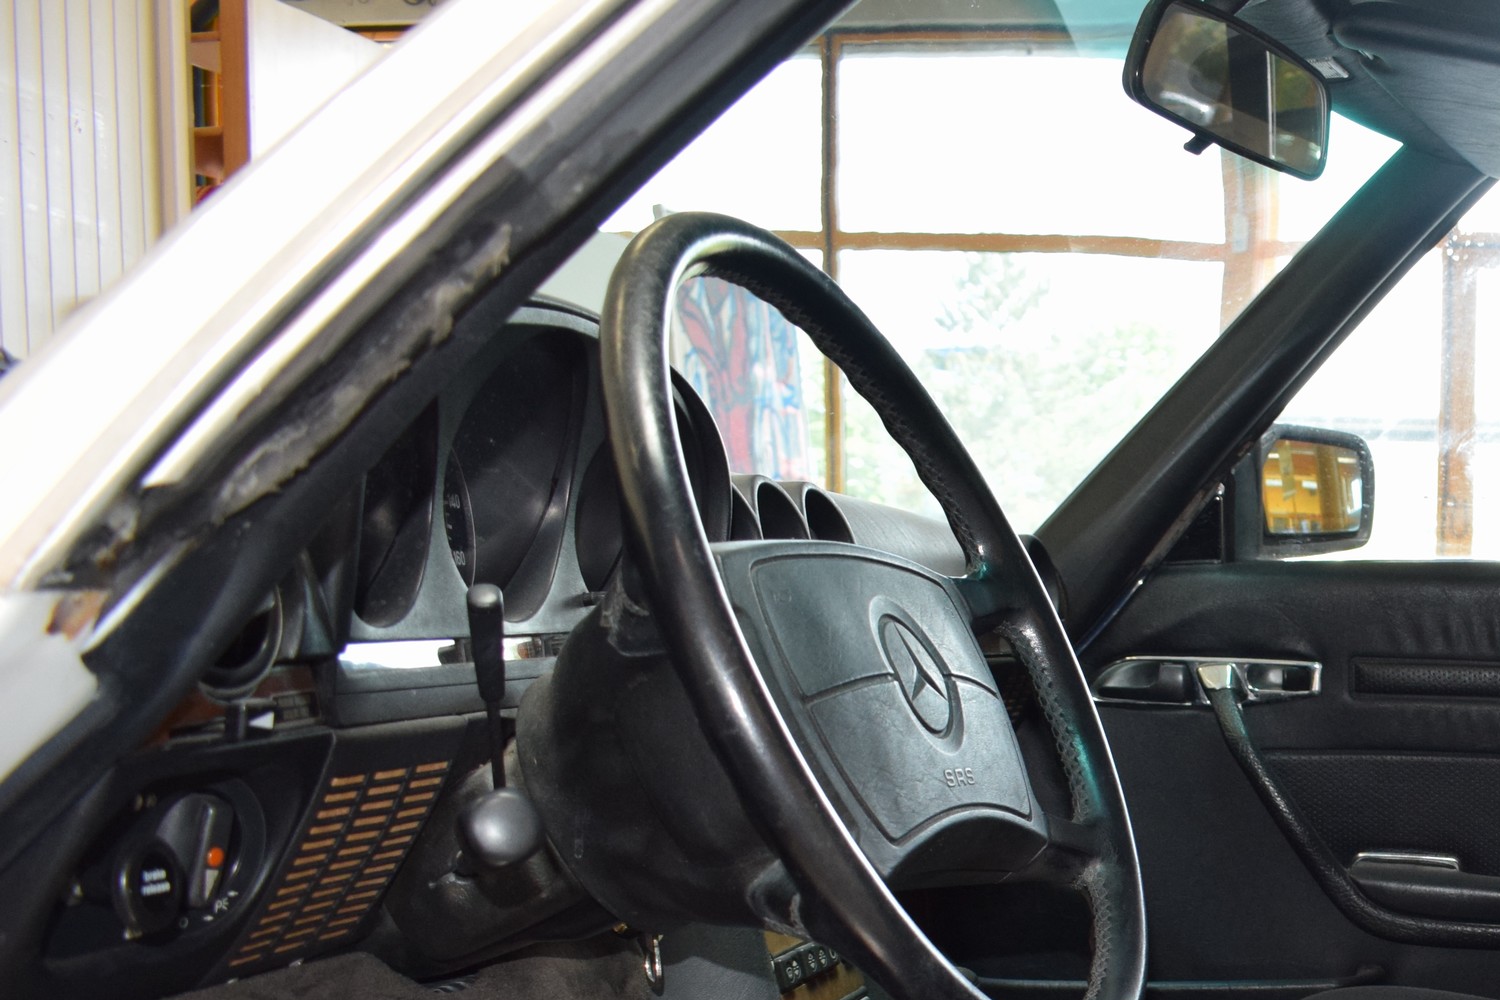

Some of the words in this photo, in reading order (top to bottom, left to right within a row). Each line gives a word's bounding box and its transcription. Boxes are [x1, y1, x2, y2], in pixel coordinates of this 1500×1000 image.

[453, 550, 466, 566] 160
[943, 767, 976, 788] SRS
[141, 881, 171, 896] release
